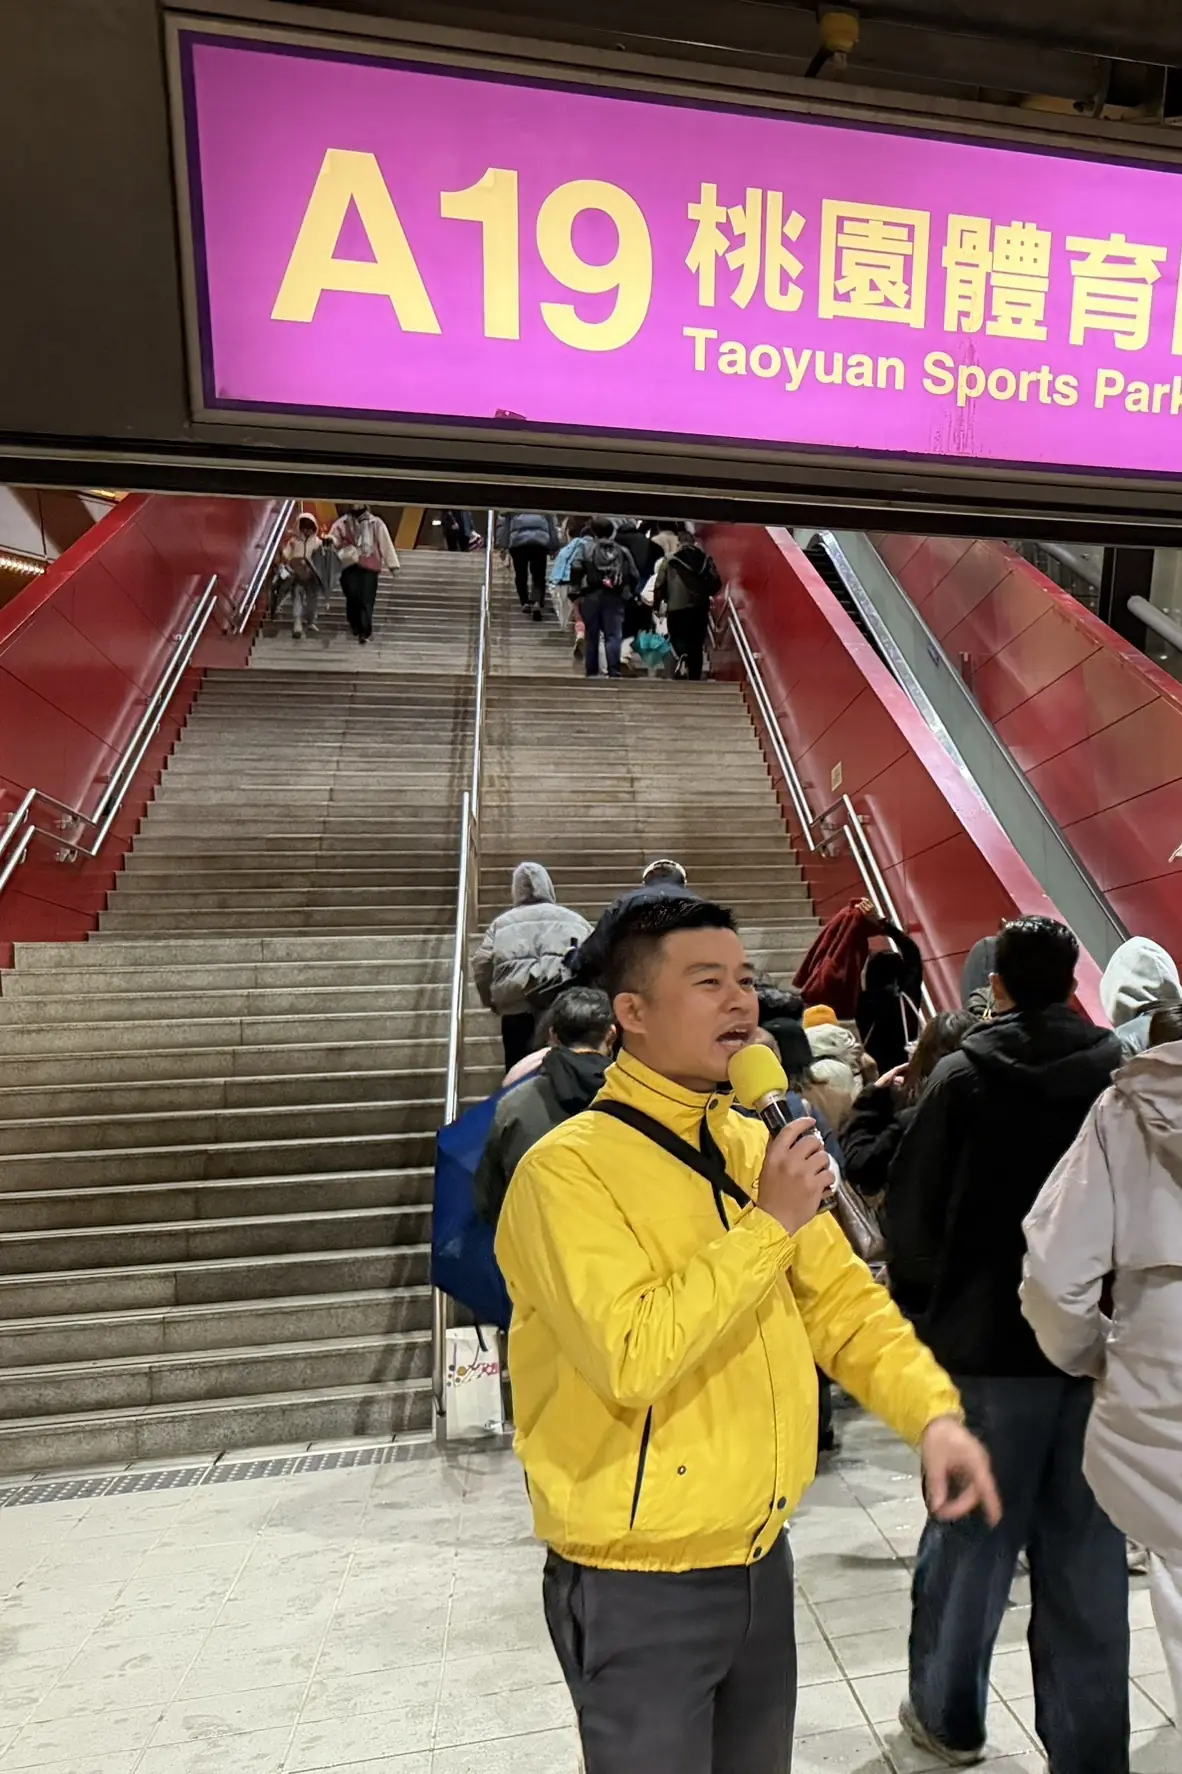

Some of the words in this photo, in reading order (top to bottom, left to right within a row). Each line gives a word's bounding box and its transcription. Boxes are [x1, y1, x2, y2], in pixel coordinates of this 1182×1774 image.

[272, 149, 652, 351] A19
[685, 328, 904, 391] Taoyuan
[924, 353, 1078, 406] Sports
